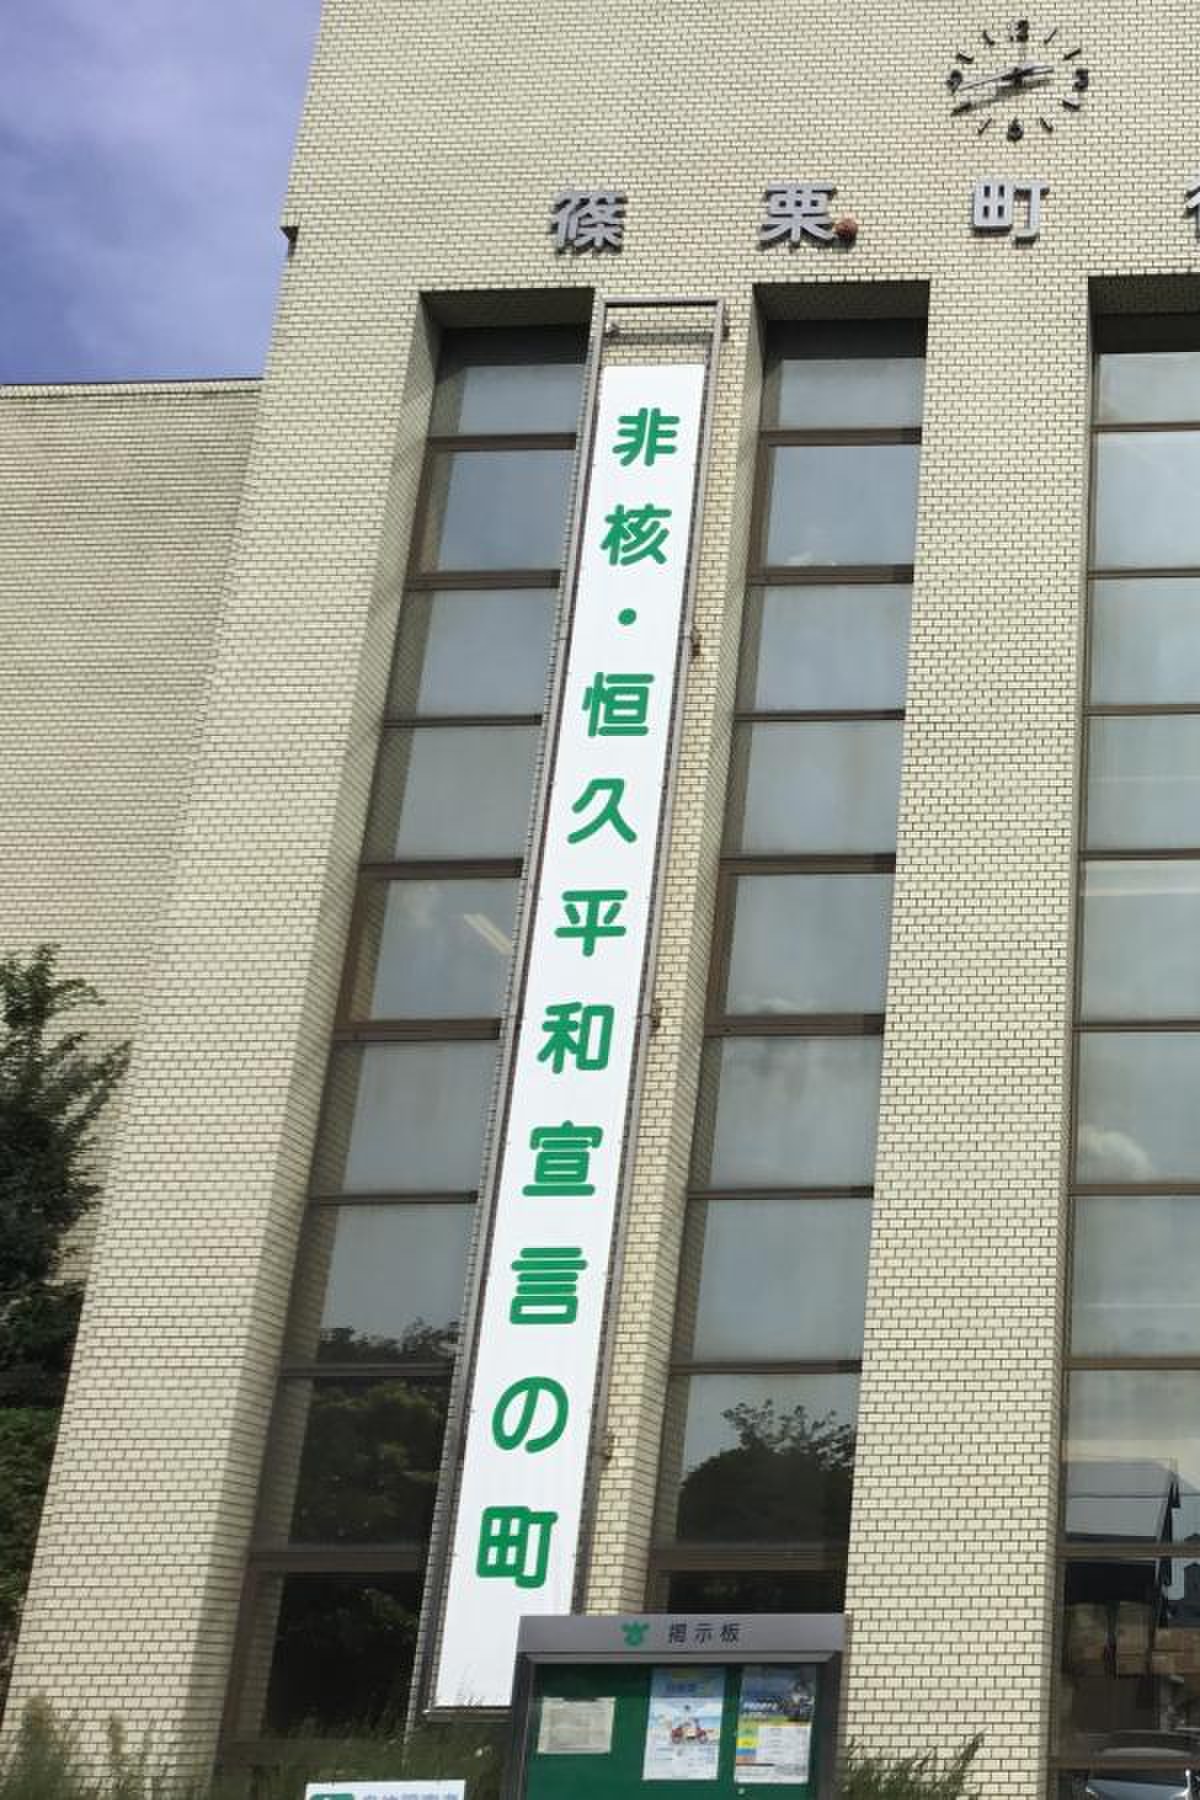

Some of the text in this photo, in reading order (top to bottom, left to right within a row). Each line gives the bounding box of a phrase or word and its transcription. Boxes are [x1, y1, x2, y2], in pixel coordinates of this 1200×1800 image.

[475, 406, 681, 1589] 非核・恒久平和宣言の町
[668, 1622, 741, 1644] 掲示板
